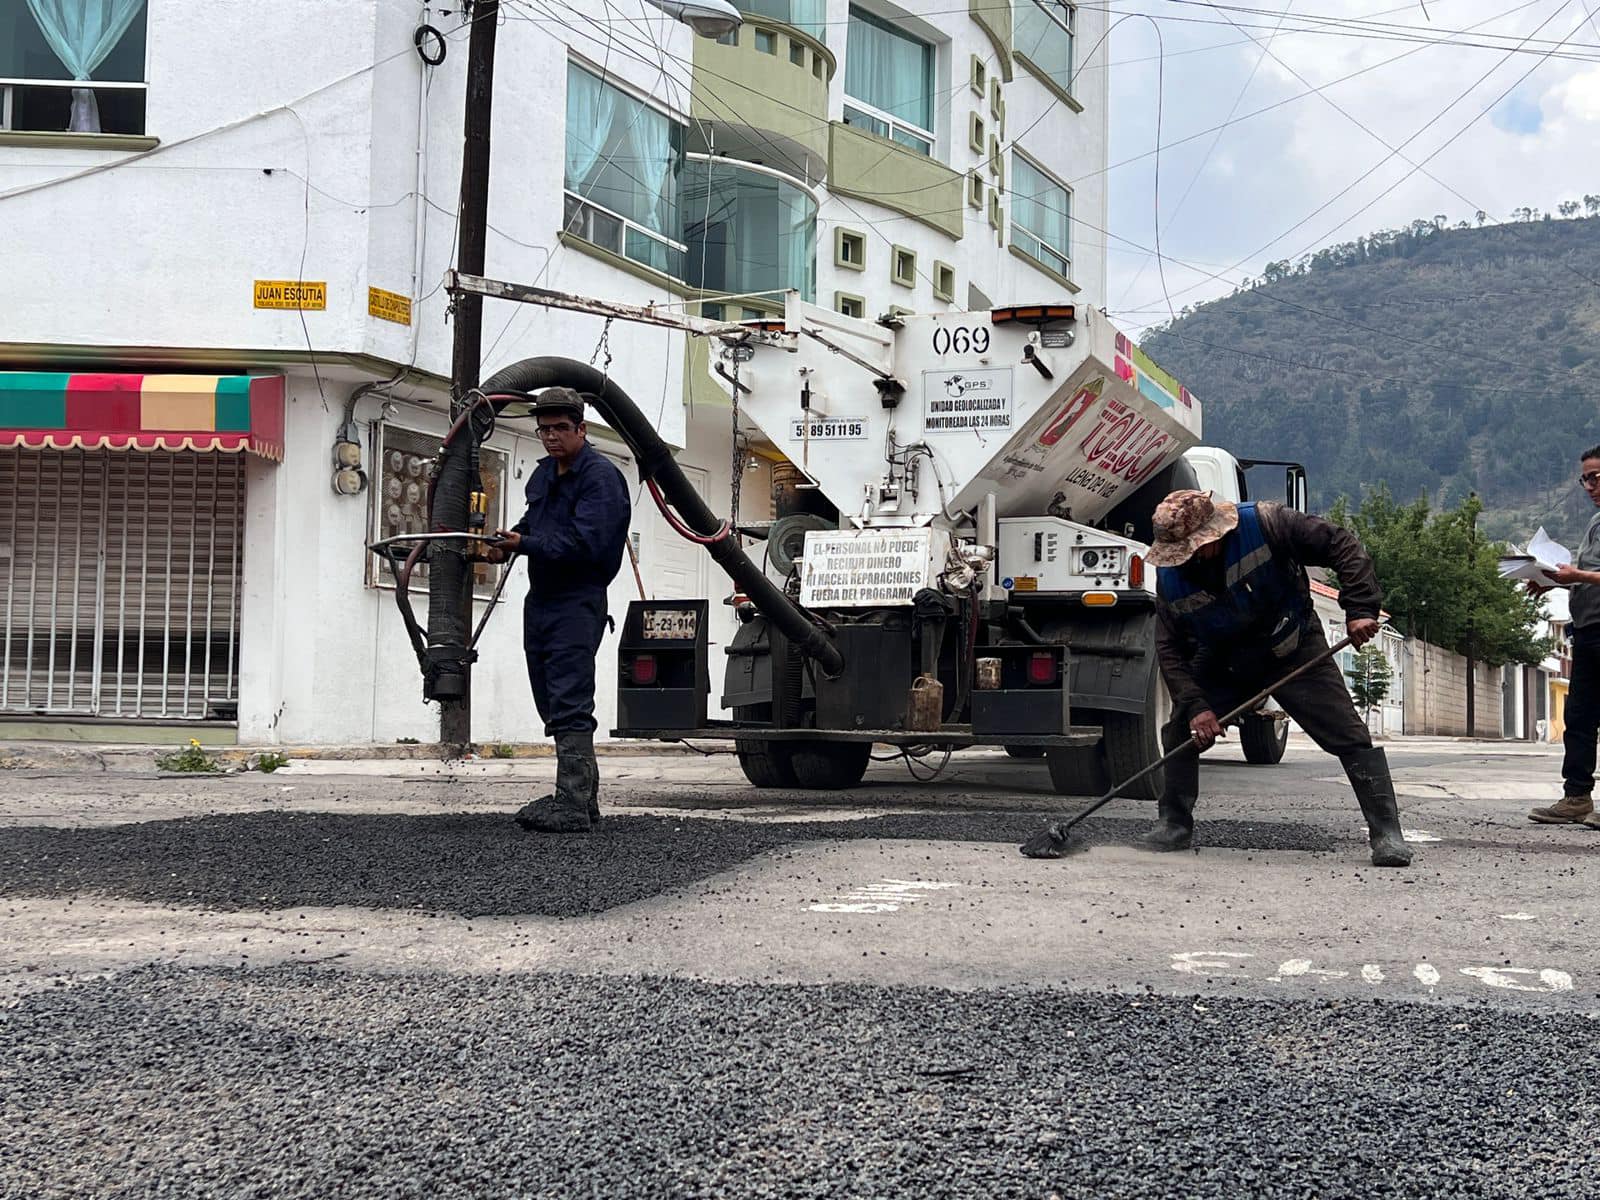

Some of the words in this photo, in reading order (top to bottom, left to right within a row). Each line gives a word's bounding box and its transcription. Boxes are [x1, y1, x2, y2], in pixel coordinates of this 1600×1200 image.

[257, 287, 282, 300] JUAN
[284, 287, 323, 301] ESCUTIA
[933, 326, 990, 356] 069
[964, 381, 987, 389] GPS
[930, 400, 953, 413] UNIDAD
[954, 399, 1001, 412] GEOLOCALIZADA
[1001, 398, 1006, 410] Y
[926, 416, 968, 429] MONITOREADA
[968, 415, 980, 427] LAS
[980, 415, 989, 427] 24
[989, 414, 1010, 427] HORAS
[811, 424, 823, 437] 89
[825, 424, 836, 436] 51
[838, 424, 847, 436] 11
[849, 423, 862, 436] 95
[1080, 400, 1179, 485] TOLUCA
[813, 543, 823, 555] EL
[825, 541, 872, 555] PERSONAL
[873, 540, 887, 554] NO
[889, 540, 919, 553] PUEDE
[827, 557, 865, 570] RECIBIR
[866, 556, 901, 569] DINERO
[806, 574, 815, 587] NI
[818, 573, 848, 586] HACER
[850, 571, 921, 585] REPARACIONES
[811, 588, 840, 602] FUERA
[842, 588, 858, 601] DEL
[860, 587, 914, 600] PROGRAMA
